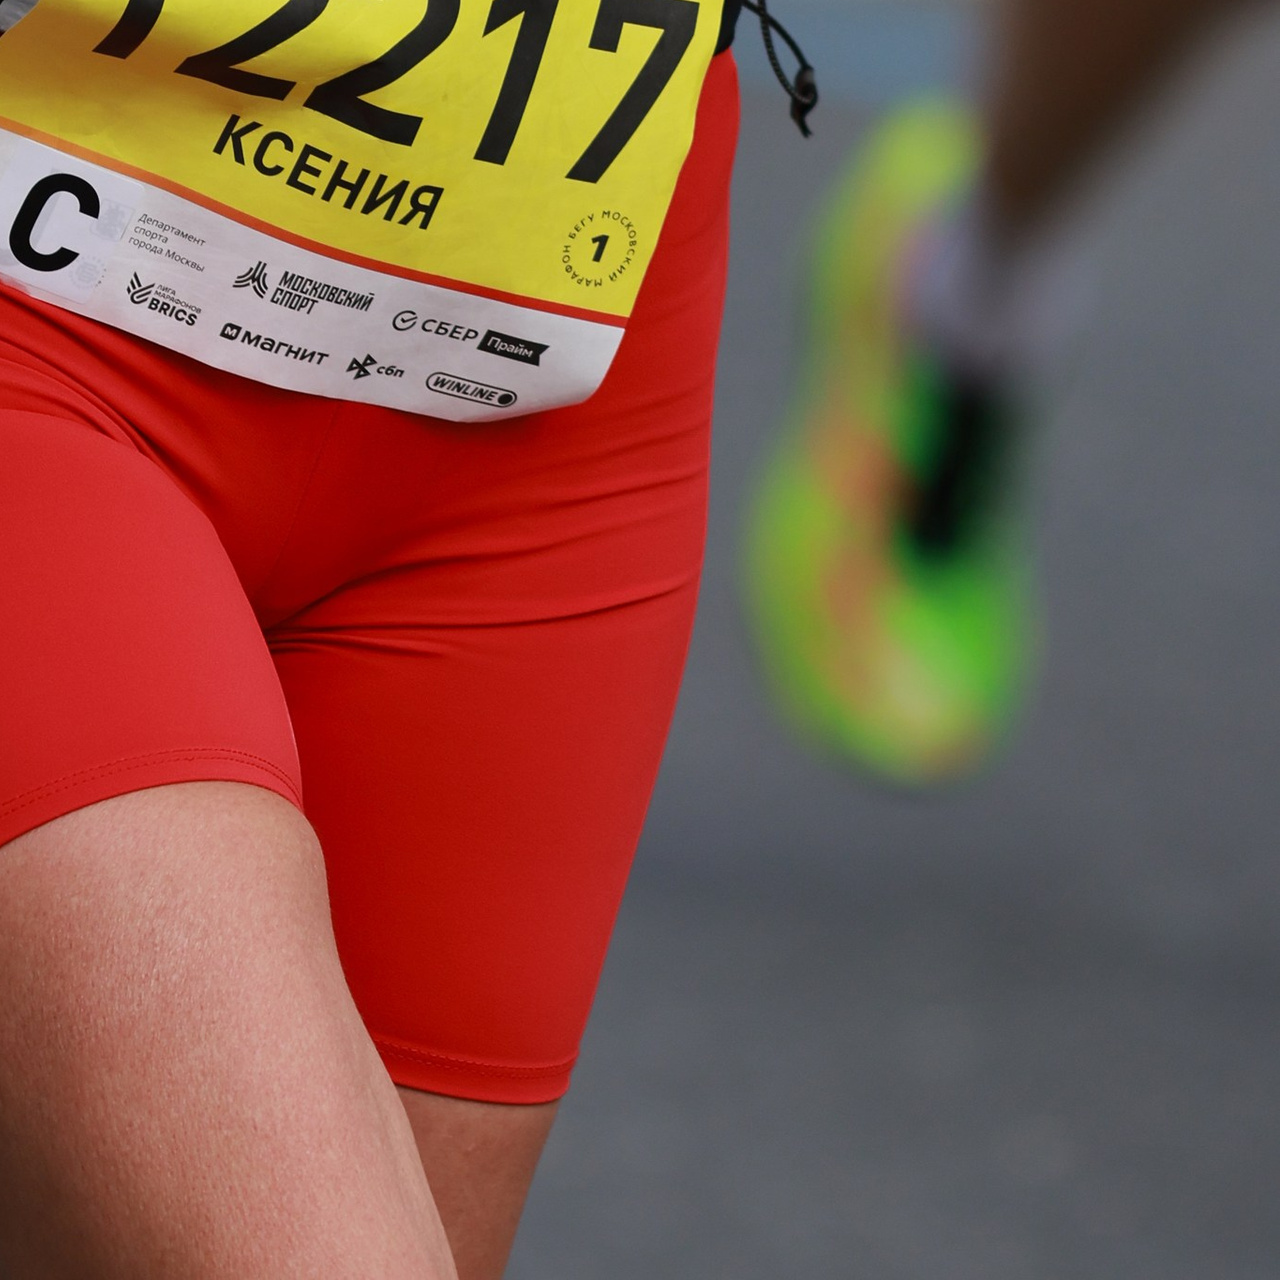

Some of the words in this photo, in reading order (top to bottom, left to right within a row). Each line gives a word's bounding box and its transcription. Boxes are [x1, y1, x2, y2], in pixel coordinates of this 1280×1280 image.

[212, 114, 444, 230] КСЕНИЯ
[133, 225, 169, 244] спорта
[138, 213, 206, 247] Департамент
[568, 213, 594, 240] БЕГУ
[128, 236, 163, 255] города
[164, 249, 205, 272] Москвы
[591, 234, 610, 262] 1
[601, 210, 637, 281] МОСКОВСКИЙ
[562, 245, 602, 287] МАРАФОН
[153, 290, 202, 315] МАРАФОНОВ
[157, 284, 177, 296] ЛИГА
[270, 287, 319, 315] СПОРТ
[278, 270, 375, 312] МОСКОВСКИЙ
[147, 297, 198, 326] BRICS
[421, 318, 479, 342] СБЕР
[486, 336, 534, 358] Прайм
[433, 376, 498, 402] WINLINE
